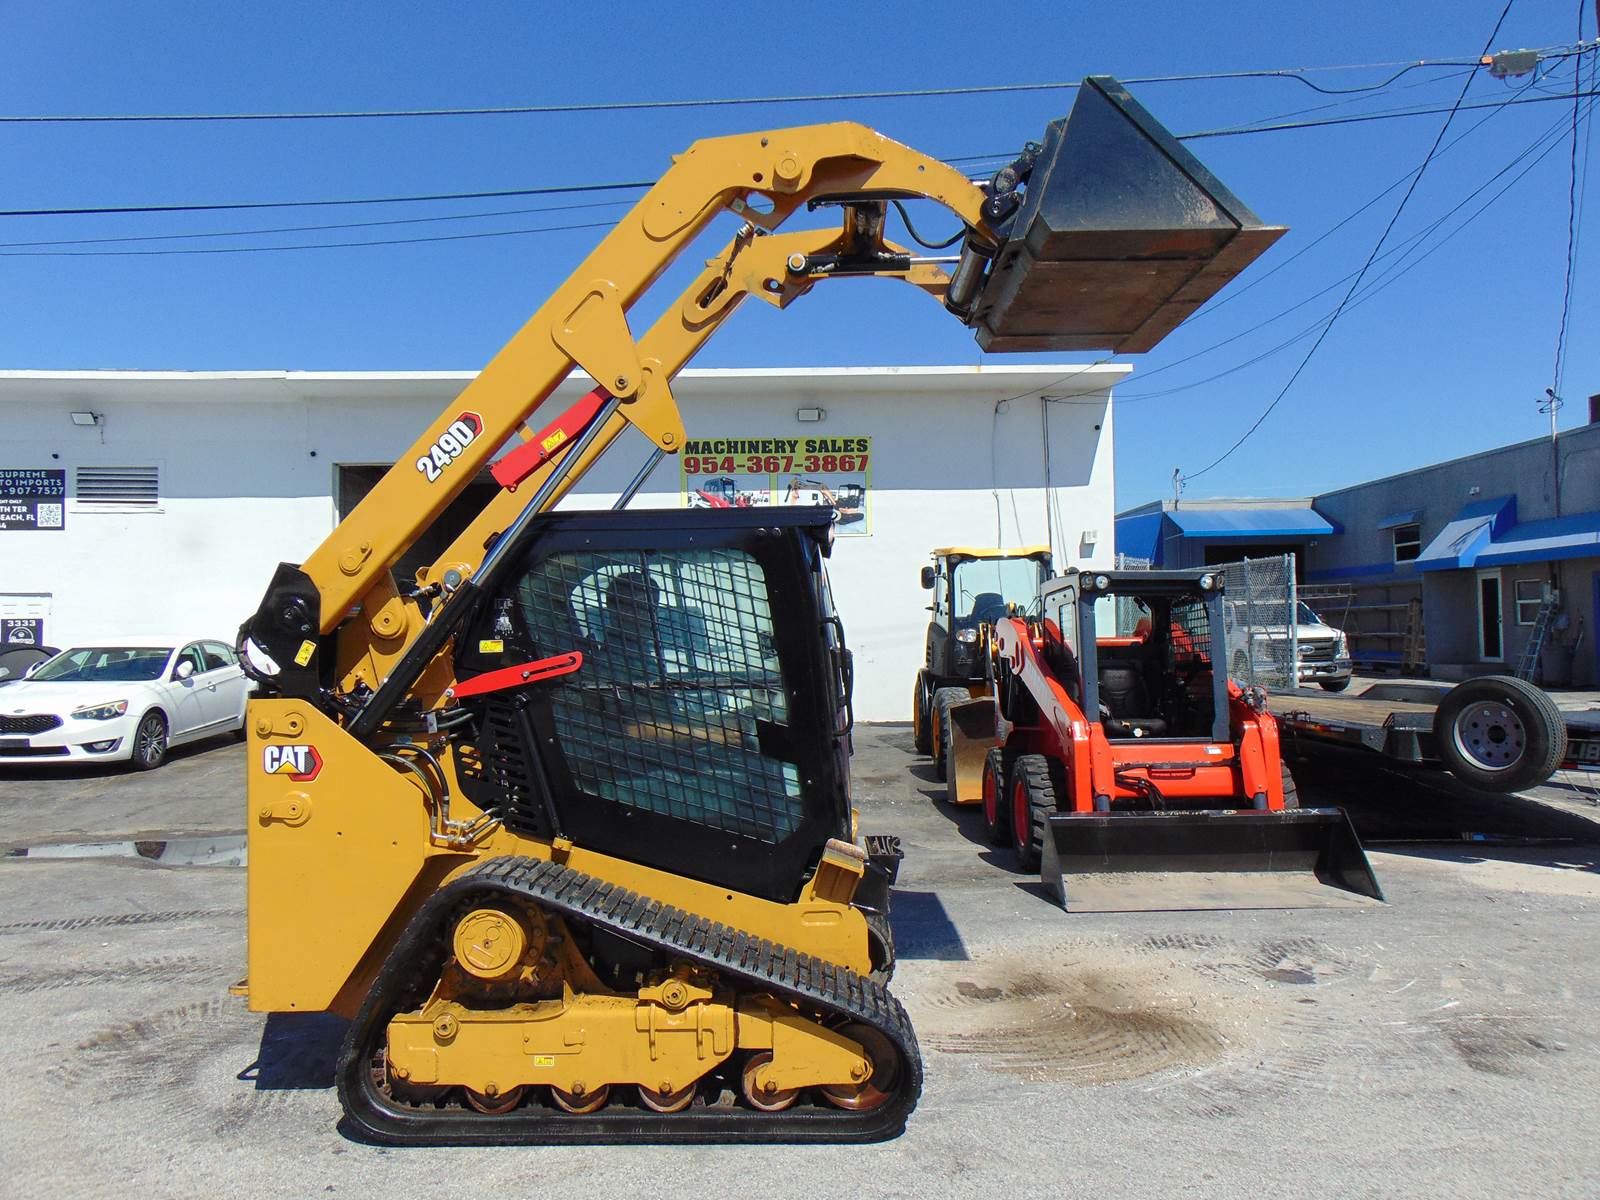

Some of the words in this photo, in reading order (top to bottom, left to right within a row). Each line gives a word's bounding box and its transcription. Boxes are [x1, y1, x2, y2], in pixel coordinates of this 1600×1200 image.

[415, 420, 476, 483] 249D
[685, 440, 799, 454] MACHINERY
[805, 439, 868, 453] SALES
[684, 455, 869, 473] 954-367-3867
[0, 514, 25, 522] EACH,
[7, 619, 36, 627] 3333
[264, 745, 309, 774] CAT
